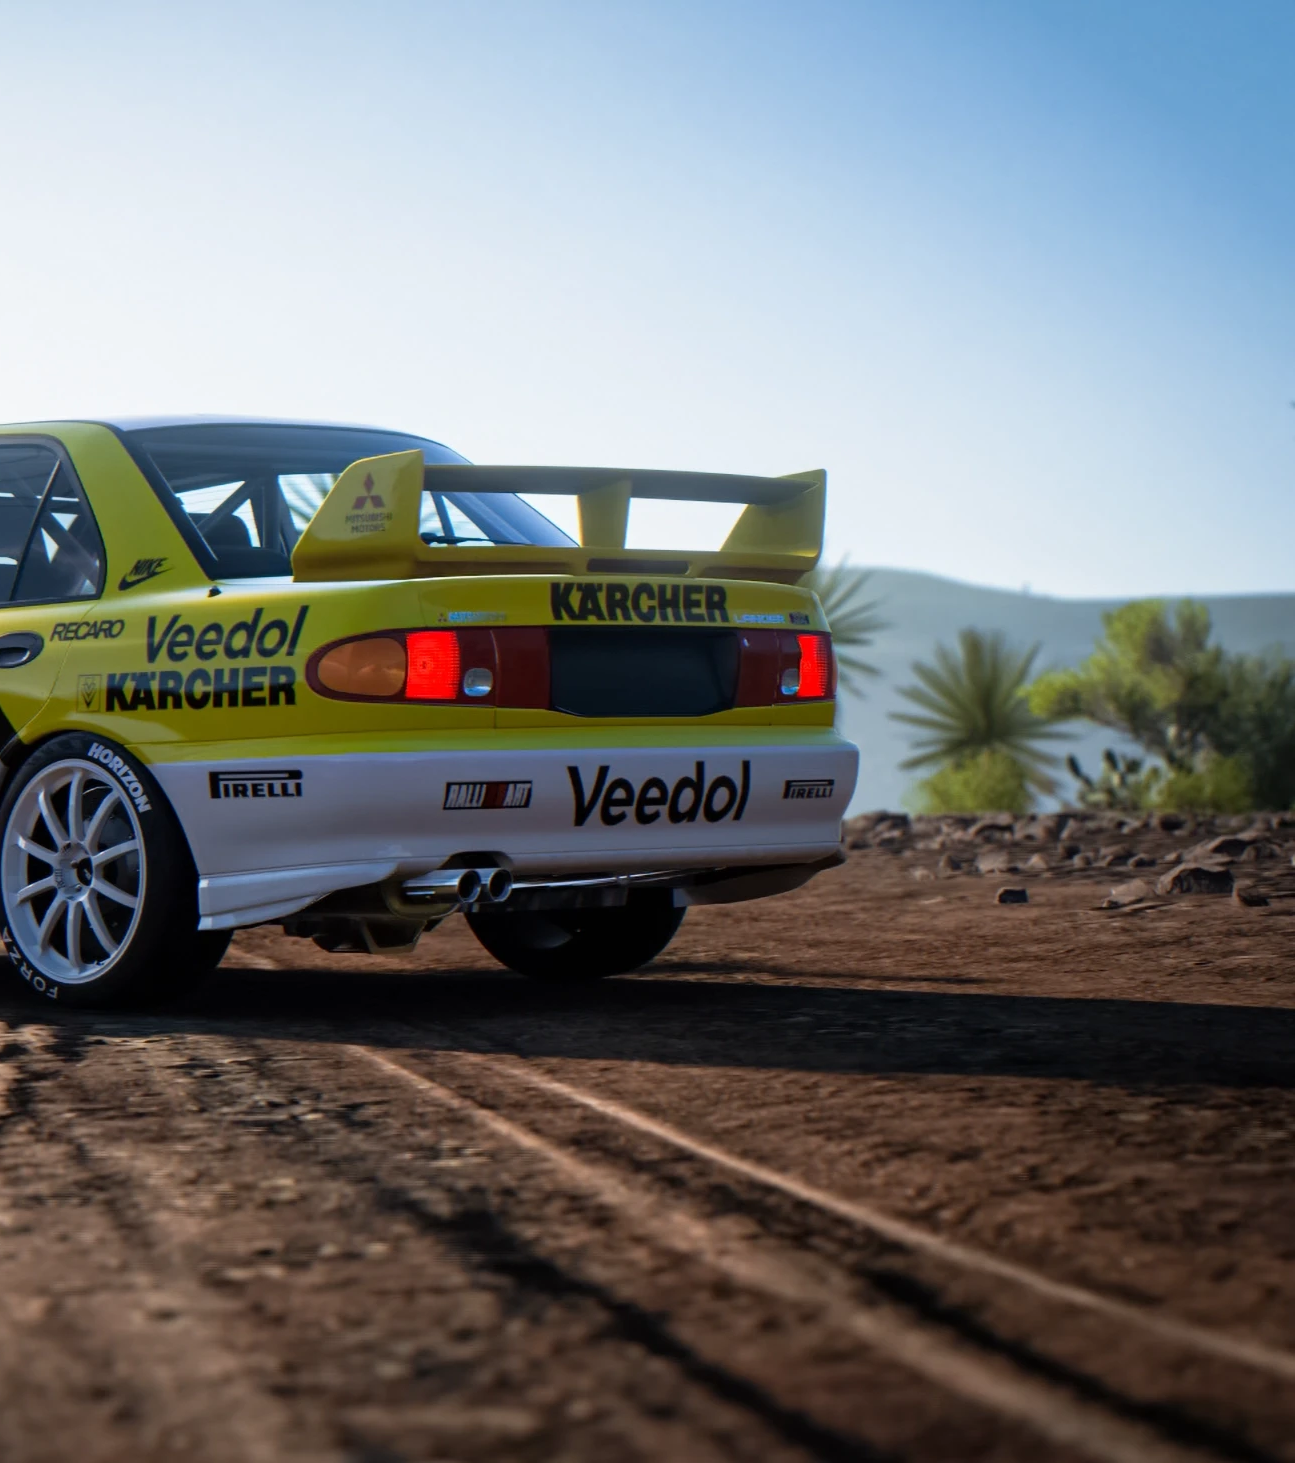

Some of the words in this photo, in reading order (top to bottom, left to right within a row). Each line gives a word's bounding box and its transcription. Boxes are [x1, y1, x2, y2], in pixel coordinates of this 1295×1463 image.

[345, 512, 393, 523] MITSUBISHI
[351, 523, 386, 533] MOTORS
[129, 557, 168, 577] NIKE
[550, 582, 729, 623] KÄRCHER
[50, 619, 126, 641] RECARO
[147, 605, 310, 664] Veedol
[105, 666, 297, 713] KÄRCHER
[87, 742, 152, 813] HORIZON
[209, 770, 303, 799] PIRELLI
[566, 760, 751, 827] Veedol
[782, 779, 835, 799] PIRELLI
[3, 926, 58, 999] FORZA
